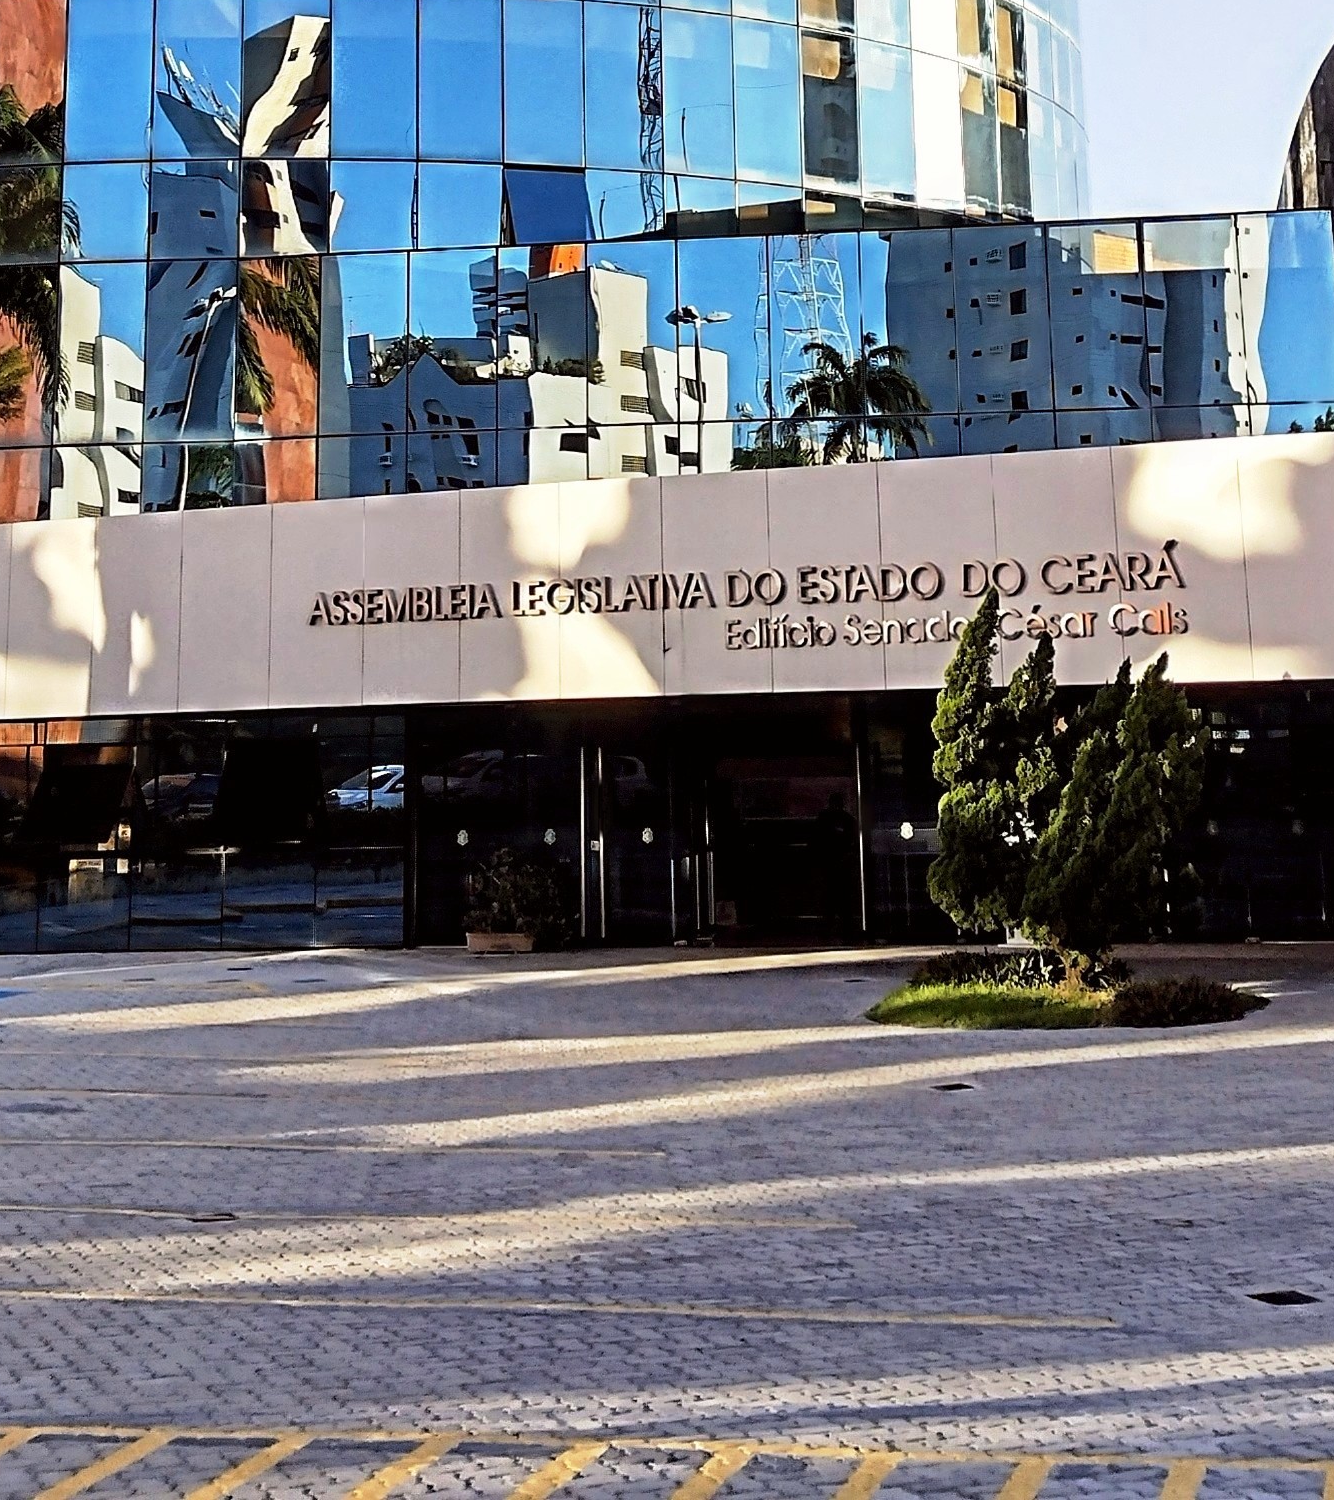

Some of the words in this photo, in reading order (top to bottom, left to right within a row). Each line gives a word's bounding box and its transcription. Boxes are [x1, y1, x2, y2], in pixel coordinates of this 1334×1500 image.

[308, 581, 503, 627] ASSEMBLEIA
[512, 571, 717, 618] LEGISLATIVA
[724, 565, 788, 608] DO
[797, 560, 946, 606] ESTADO
[961, 558, 1027, 599] DO
[1040, 539, 1187, 595] CEARÁ
[724, 612, 836, 651] Edifício
[843, 609, 970, 647] Senado
[994, 604, 1098, 641] César
[1107, 601, 1189, 637] Cals
